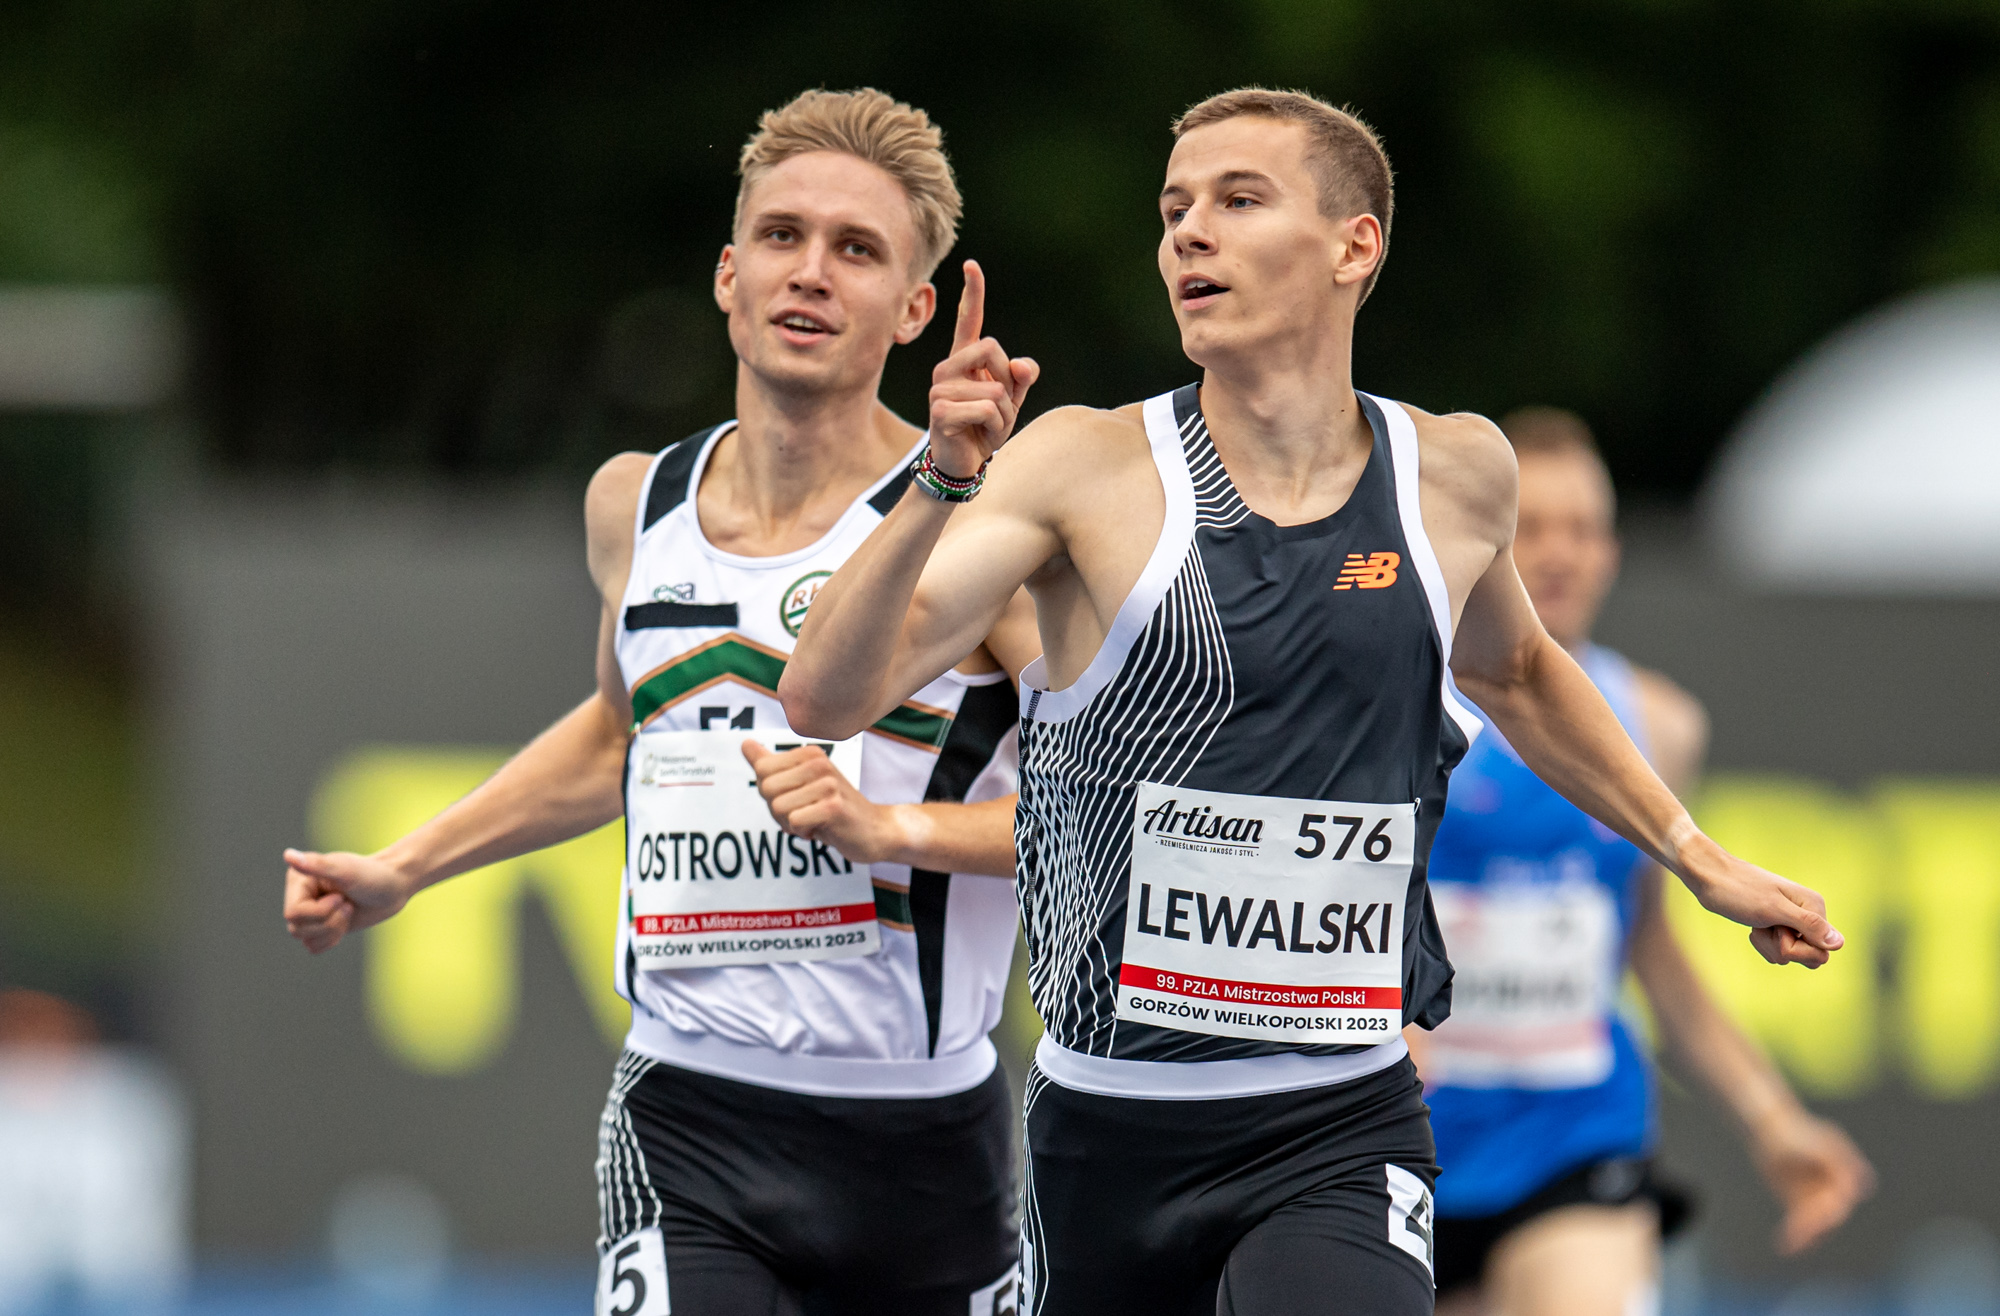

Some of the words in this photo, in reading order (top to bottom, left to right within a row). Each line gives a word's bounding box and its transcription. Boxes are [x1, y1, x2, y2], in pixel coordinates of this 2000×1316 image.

[1332, 551, 1400, 590] NB
[1143, 799, 1264, 843] Artisan
[1294, 813, 1392, 862] 576
[1160, 839, 1208, 853] RZEMIEŚLNICZA
[1209, 846, 1233, 856] JAKOŚĆ
[662, 916, 699, 931] PZLA
[701, 912, 792, 930] Mistrzostwa
[794, 908, 841, 926] Polski
[1137, 883, 1393, 954] LEWALSKI
[637, 941, 693, 957] ORZÓW
[698, 937, 820, 955] WIELKOPOLSKI
[825, 930, 866, 948] 2023
[1156, 974, 1179, 990] 99.
[1183, 979, 1219, 997] PZLA
[1224, 985, 1318, 1005] Mistrzostwa
[1321, 990, 1366, 1005] Polski
[1130, 996, 1210, 1021] GORZÓW
[1214, 1009, 1342, 1030] WIELKOPOLSKI
[1346, 1017, 1388, 1031] 2023
[611, 1240, 647, 1316] 5
